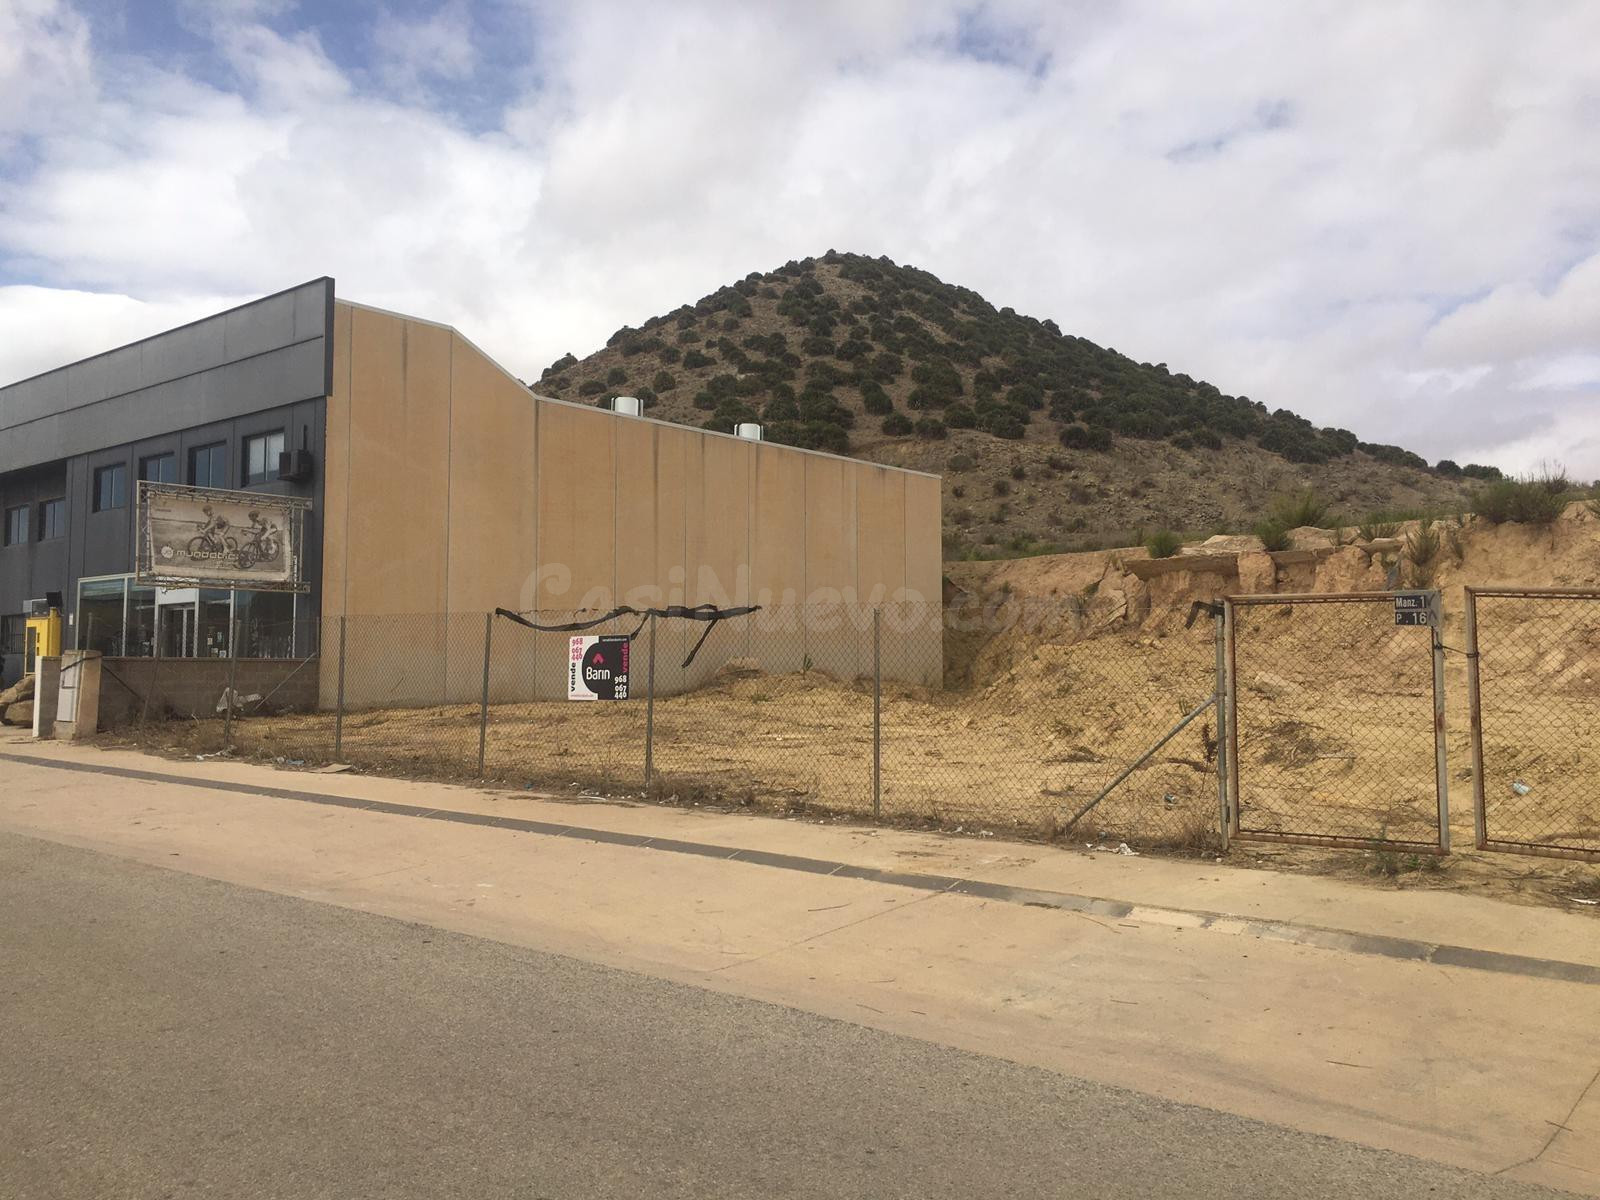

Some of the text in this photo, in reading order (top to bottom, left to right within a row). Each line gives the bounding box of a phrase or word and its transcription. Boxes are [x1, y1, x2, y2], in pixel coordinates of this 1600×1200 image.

[1395, 596, 1425, 608] Manz. 1
[1412, 612, 1427, 625] 16
[572, 638, 583, 646] 968
[572, 647, 583, 655] 067
[621, 643, 629, 673] vende
[614, 675, 627, 684] 968
[614, 684, 627, 692] 067
[614, 691, 627, 699] 440
